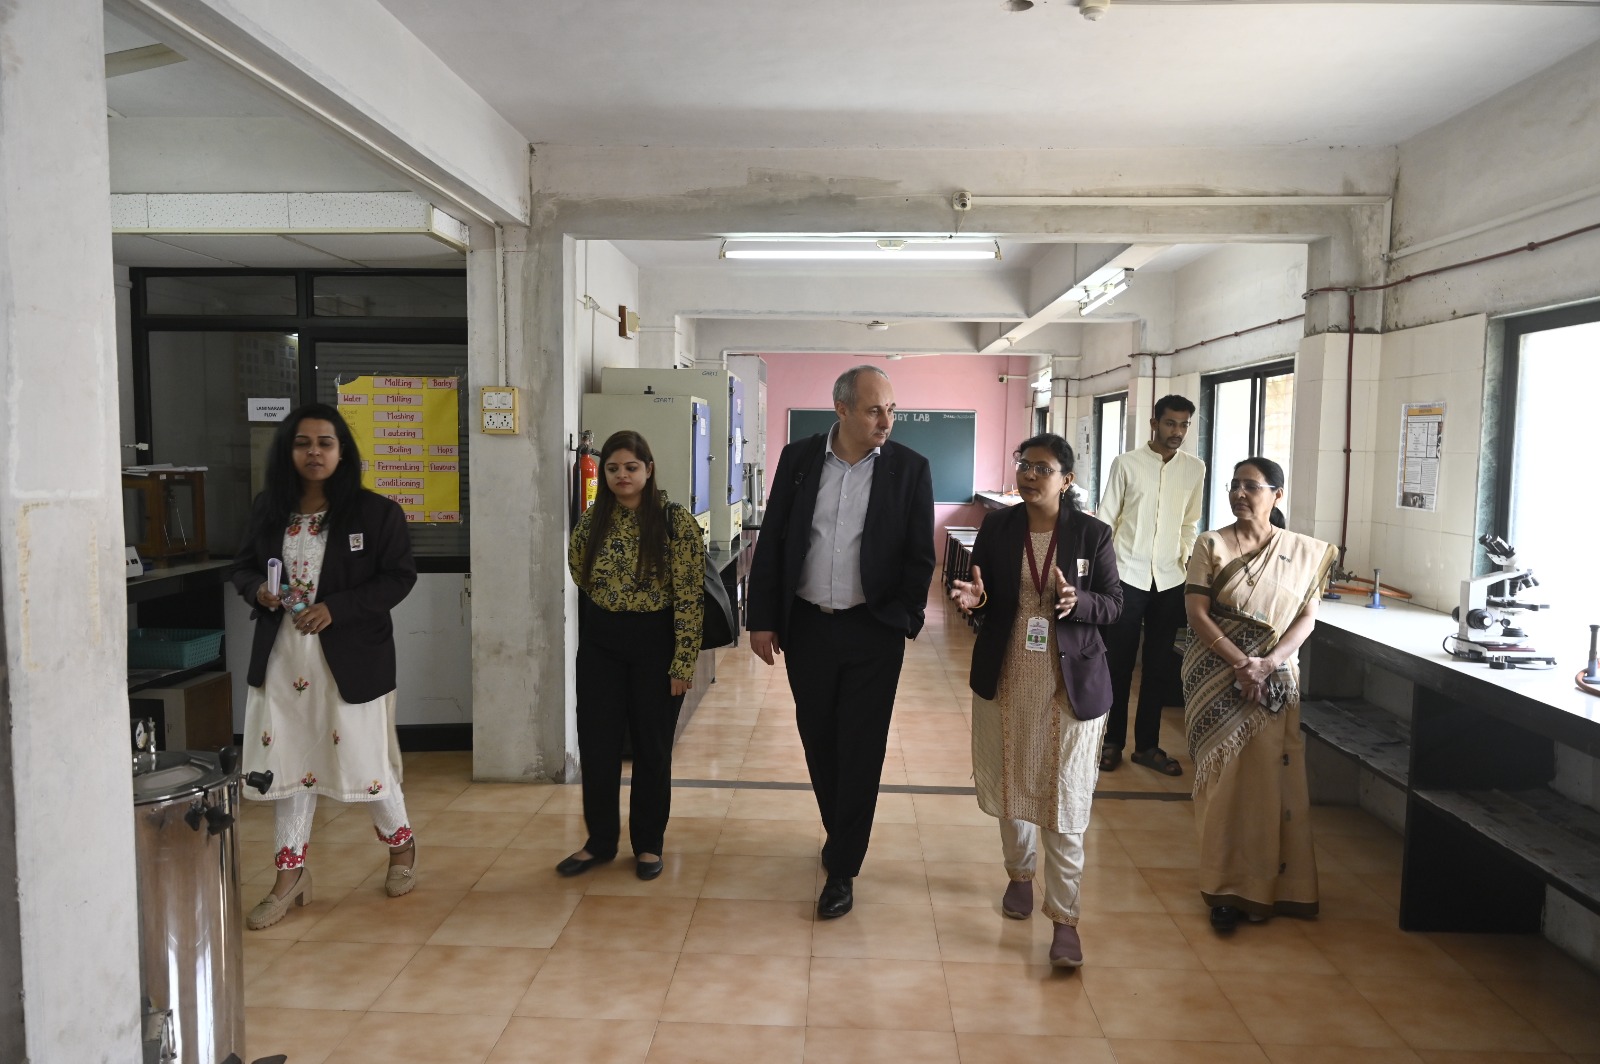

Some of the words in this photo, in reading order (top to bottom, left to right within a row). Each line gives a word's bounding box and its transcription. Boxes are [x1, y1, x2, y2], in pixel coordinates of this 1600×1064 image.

[384, 378, 412, 388] Malting
[432, 379, 453, 388] Barley
[343, 395, 362, 403] Water
[386, 395, 412, 404] Milling
[386, 412, 415, 422] Mashing
[913, 413, 930, 422] LAB
[387, 445, 412, 455] Boiling
[437, 446, 453, 455] Hops
[377, 461, 420, 472] Fermenting
[377, 478, 421, 488] Conditioning
[436, 511, 455, 520] Cans
